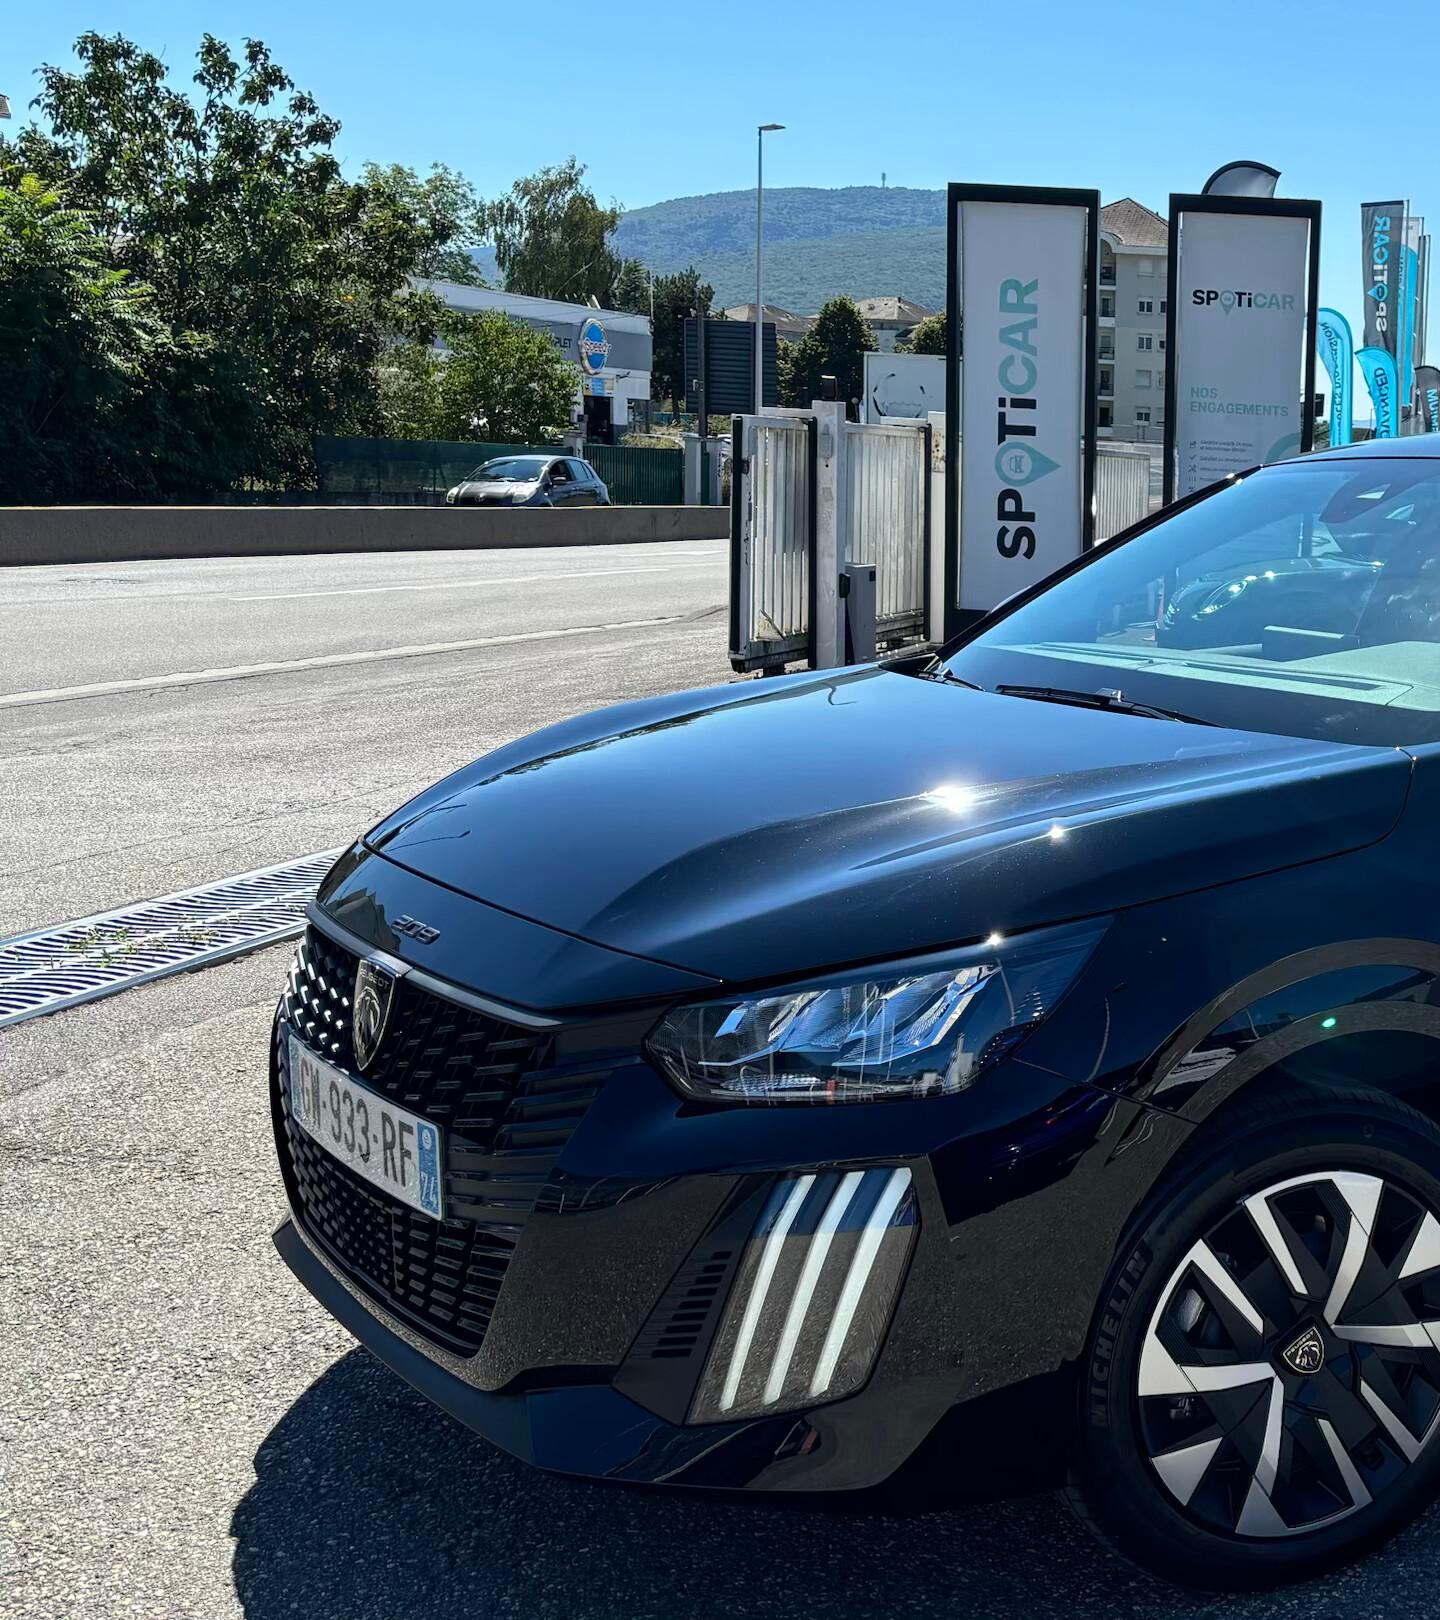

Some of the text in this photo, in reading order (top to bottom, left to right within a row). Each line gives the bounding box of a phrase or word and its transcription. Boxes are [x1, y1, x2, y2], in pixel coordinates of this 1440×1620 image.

[1190, 387, 1218, 399] NOS
[1190, 401, 1289, 417] ENGAGEMENTS
[391, 914, 441, 944] 208
[1090, 1249, 1148, 1427] MICHELIN
